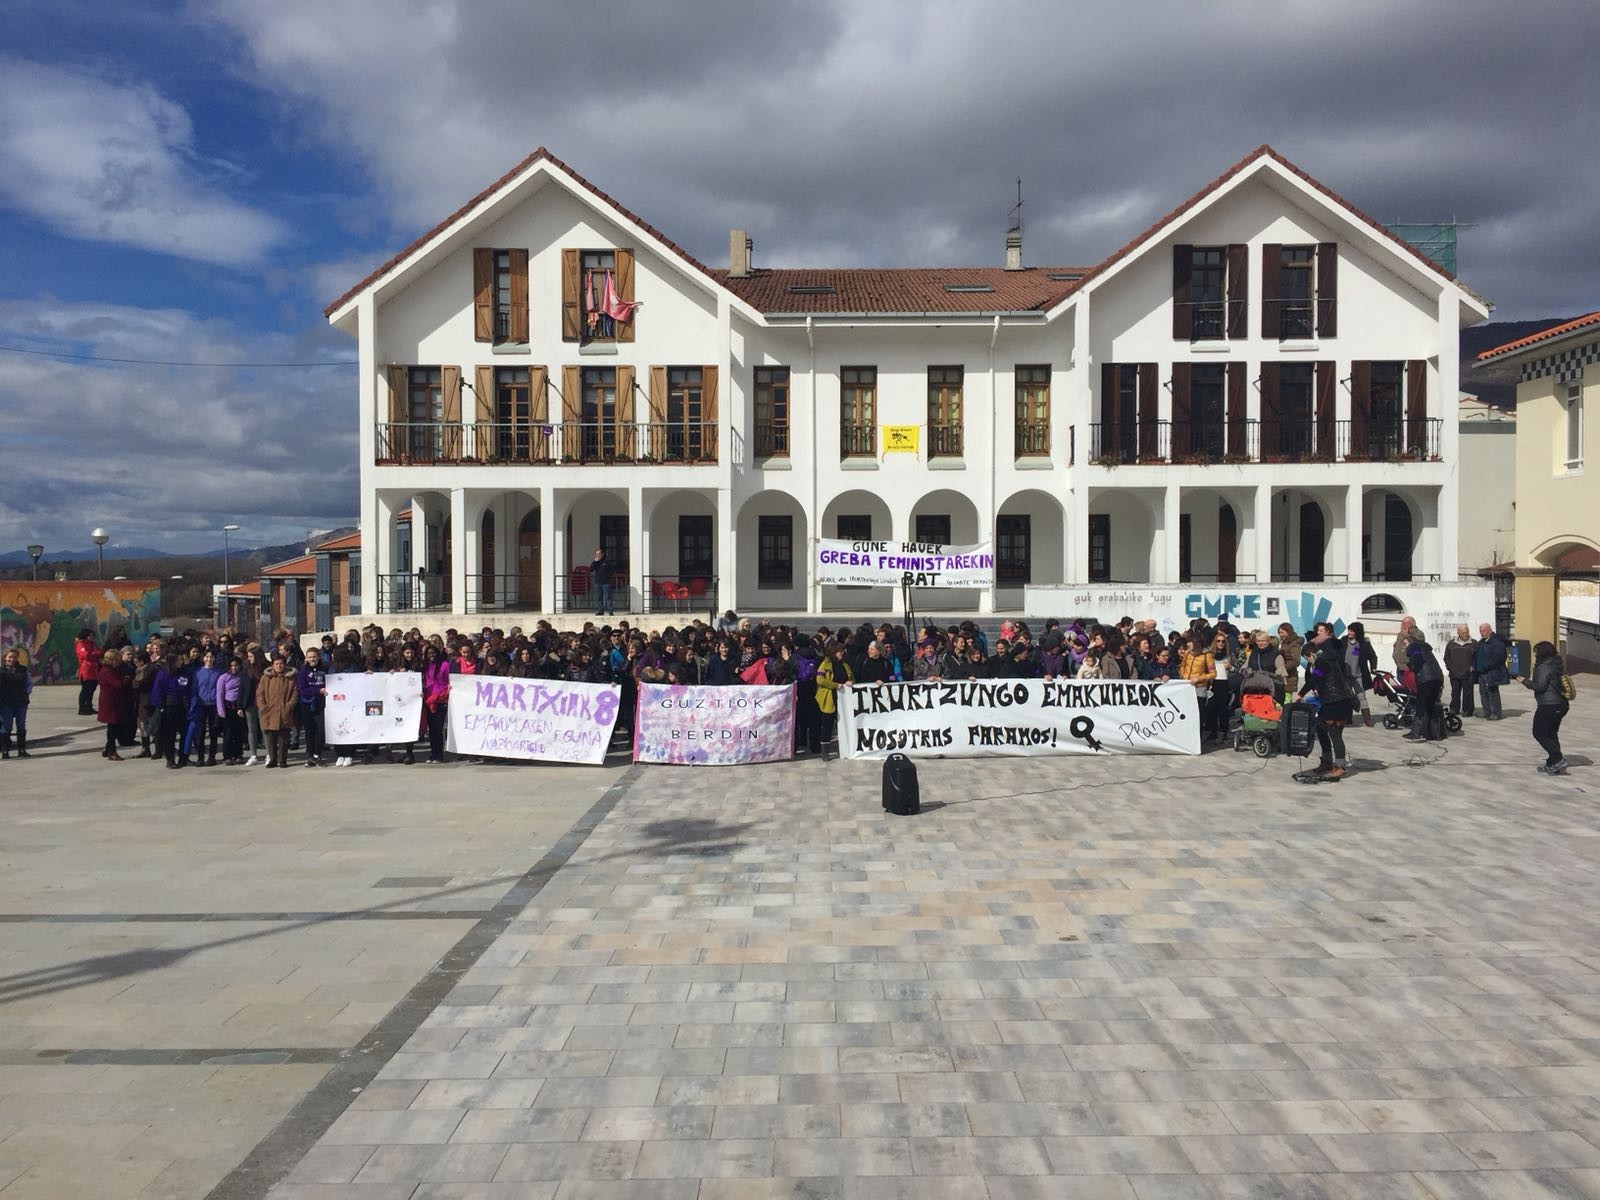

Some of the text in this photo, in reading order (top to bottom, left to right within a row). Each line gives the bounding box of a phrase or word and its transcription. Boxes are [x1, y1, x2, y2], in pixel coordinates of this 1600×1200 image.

[852, 541, 942, 555] GUNE HAUEK
[820, 550, 994, 571] GREBA FEMINISTAREKIN
[903, 571, 941, 587] BAT
[1074, 592, 1092, 605] guk
[661, 698, 764, 709] GUZTIOK
[851, 682, 1166, 716] IRURTZUNGO EMAKUMEOK
[594, 690, 618, 726] 8
[671, 729, 759, 740] BERDIN
[856, 724, 1058, 752] NOSOTRAS PARAMOS!
